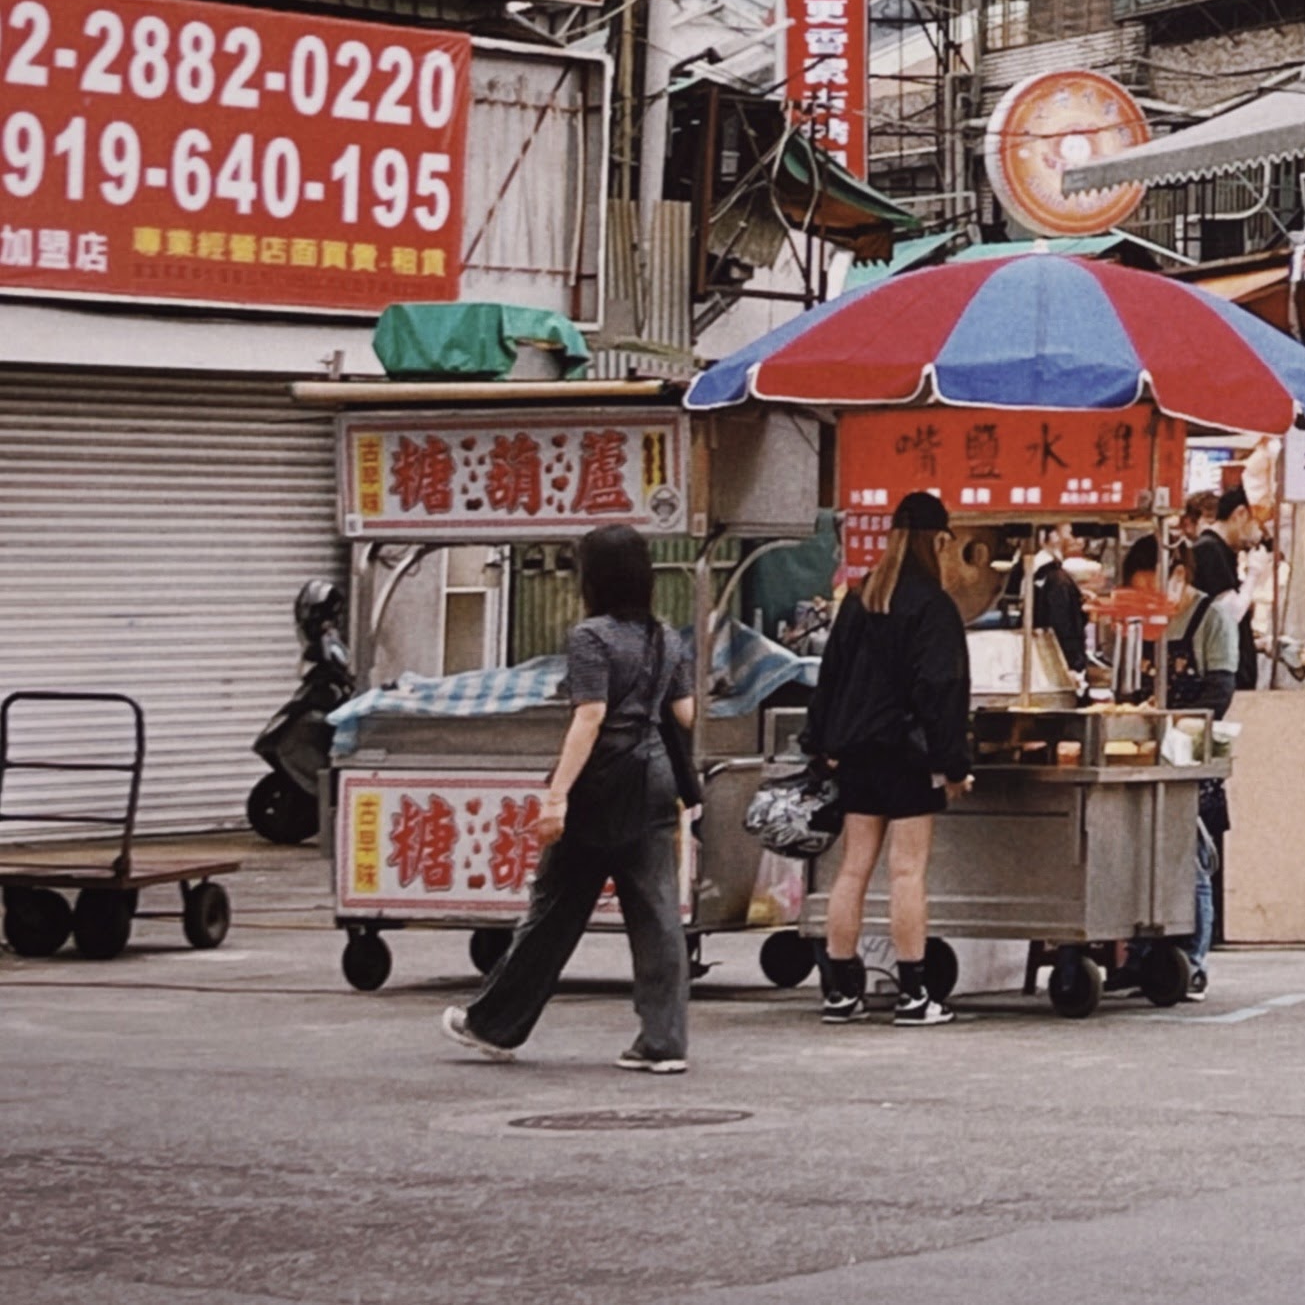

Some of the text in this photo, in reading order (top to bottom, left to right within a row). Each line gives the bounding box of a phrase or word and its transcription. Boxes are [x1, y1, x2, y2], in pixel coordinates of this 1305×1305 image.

[5, 0, 457, 130] 2-2882-0220
[2, 110, 451, 233] 919-640-195
[0, 227, 109, 273] 加盟店
[360, 440, 381, 514] 古早味
[389, 429, 634, 516] 糖葫蘆
[355, 800, 379, 890] 古早味
